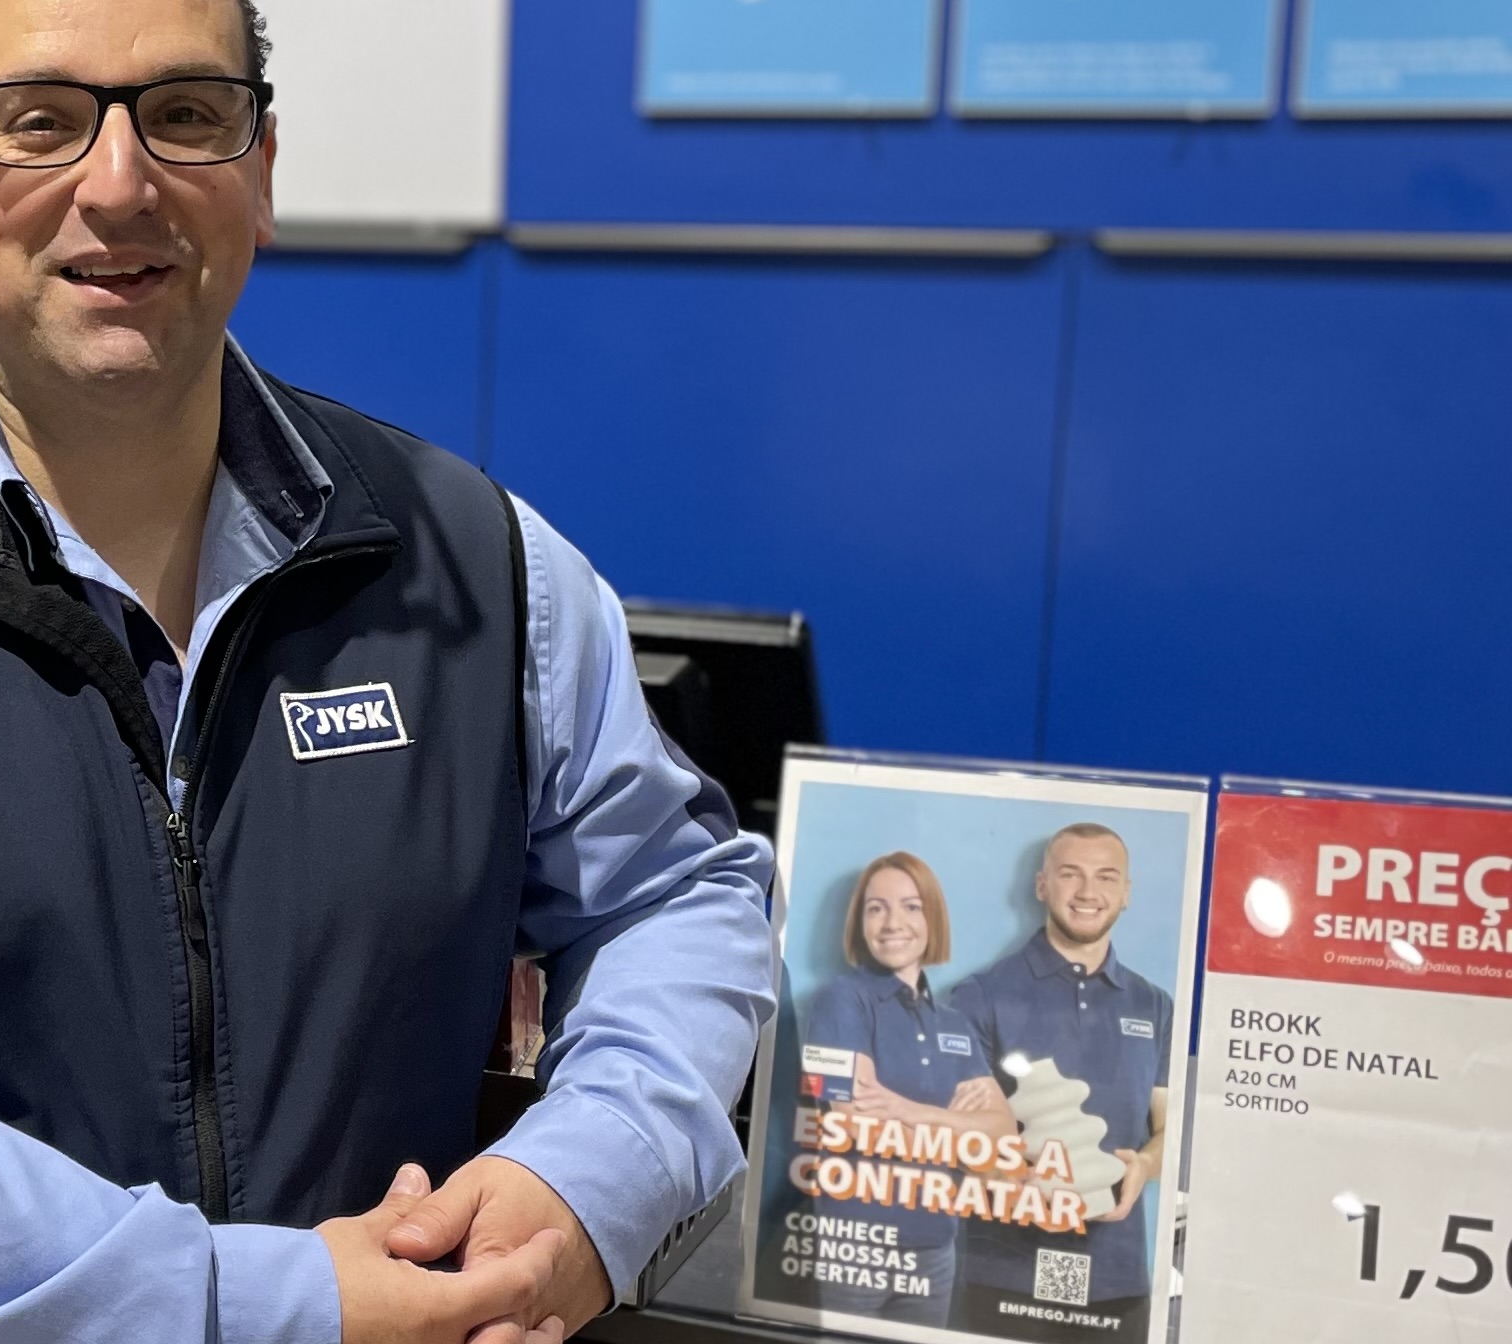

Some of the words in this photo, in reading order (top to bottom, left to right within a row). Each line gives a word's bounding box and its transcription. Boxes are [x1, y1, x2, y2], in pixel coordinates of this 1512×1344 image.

[316, 699, 392, 735] JYSK
[1314, 913, 1449, 948] SEMPRE
[1324, 951, 1335, 963] O
[1425, 959, 1463, 975] baixo,
[1466, 964, 1502, 978] todos
[1230, 1008, 1322, 1037] BROKK
[1228, 1039, 1295, 1065] ELFO
[1303, 1046, 1338, 1069] DE
[1346, 1050, 1439, 1080] NATAL
[1226, 1068, 1261, 1086] A20
[1267, 1072, 1296, 1089] CM
[1224, 1092, 1309, 1115] SORTIDO
[793, 1106, 1024, 1173] ESTAMOS
[1035, 1140, 1072, 1181] A
[789, 1154, 1085, 1230] CONTRATAR
[785, 1212, 898, 1245] CONHECE
[783, 1235, 814, 1255] AS
[819, 1239, 918, 1272] NOSSAS
[1347, 1203, 1512, 1299] 1,5
[781, 1257, 888, 1290] OFERTAS
[893, 1274, 930, 1297] EM
[999, 1302, 1121, 1330] EMPREGO.JYSK.PT
